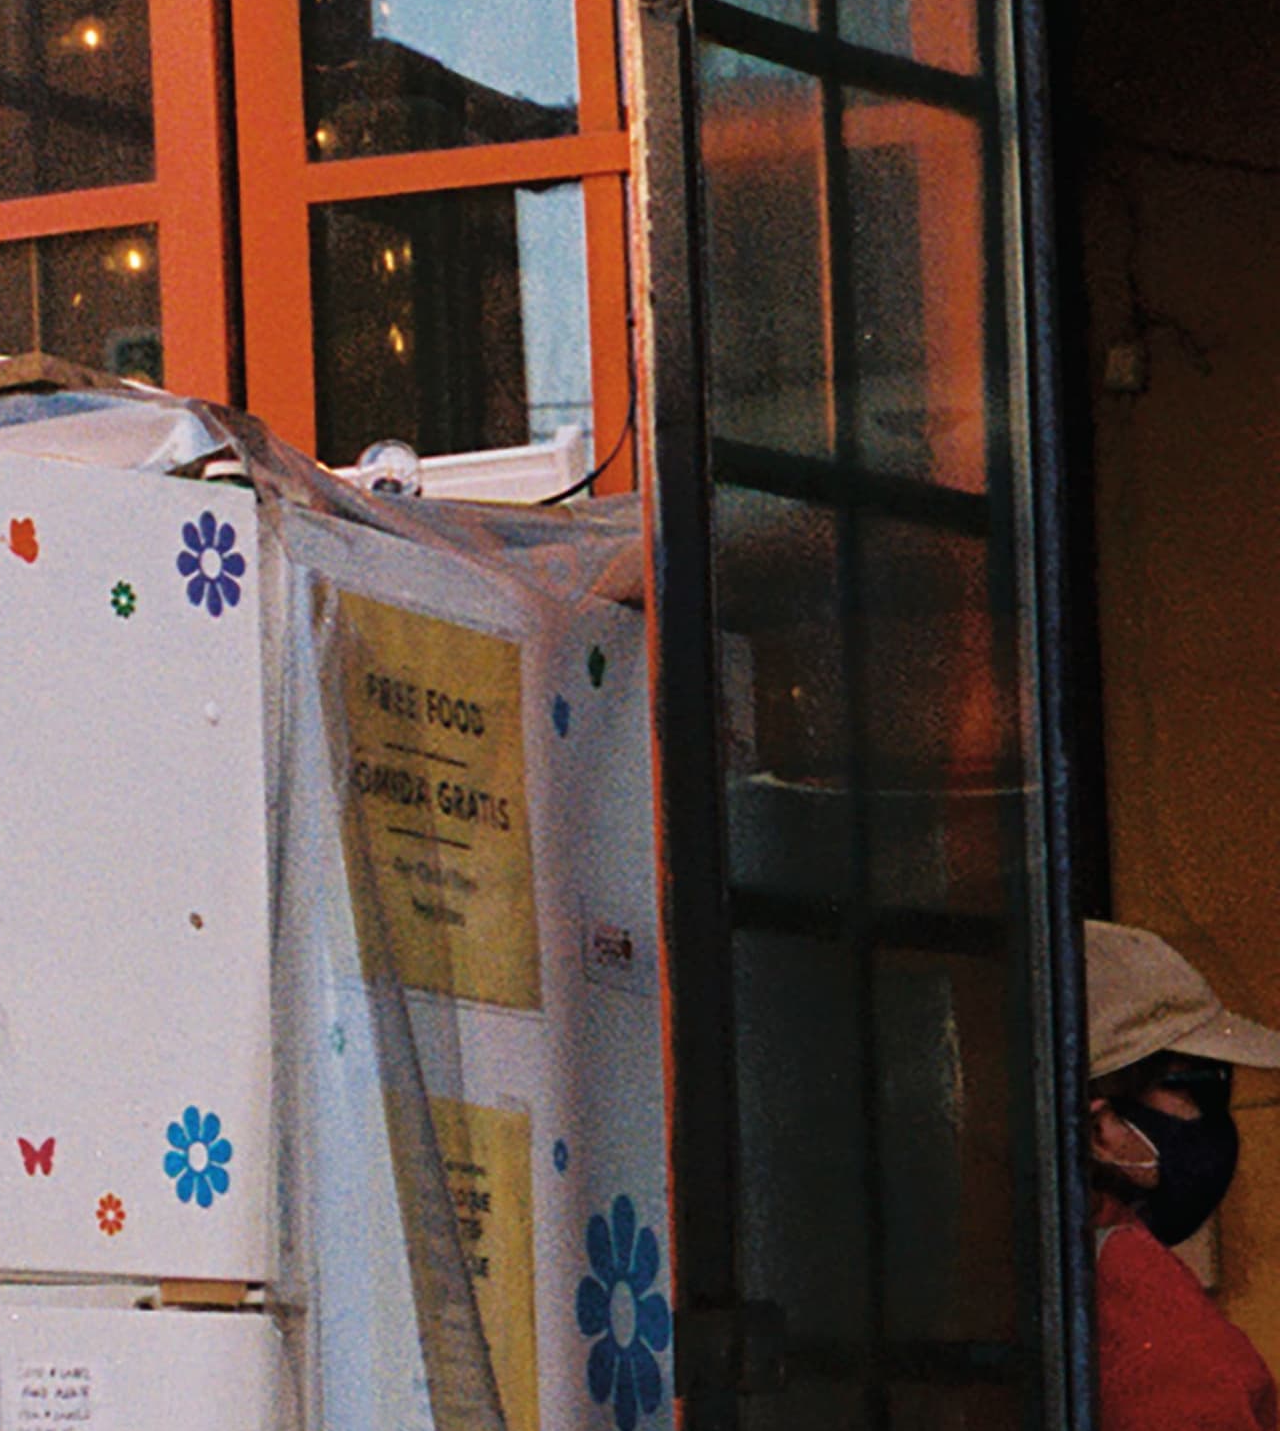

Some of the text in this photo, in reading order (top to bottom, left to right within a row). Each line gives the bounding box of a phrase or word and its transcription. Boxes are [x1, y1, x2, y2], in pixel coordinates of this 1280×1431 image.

[366, 672, 486, 738] FREE FOOD
[437, 780, 511, 832] GRATIS
